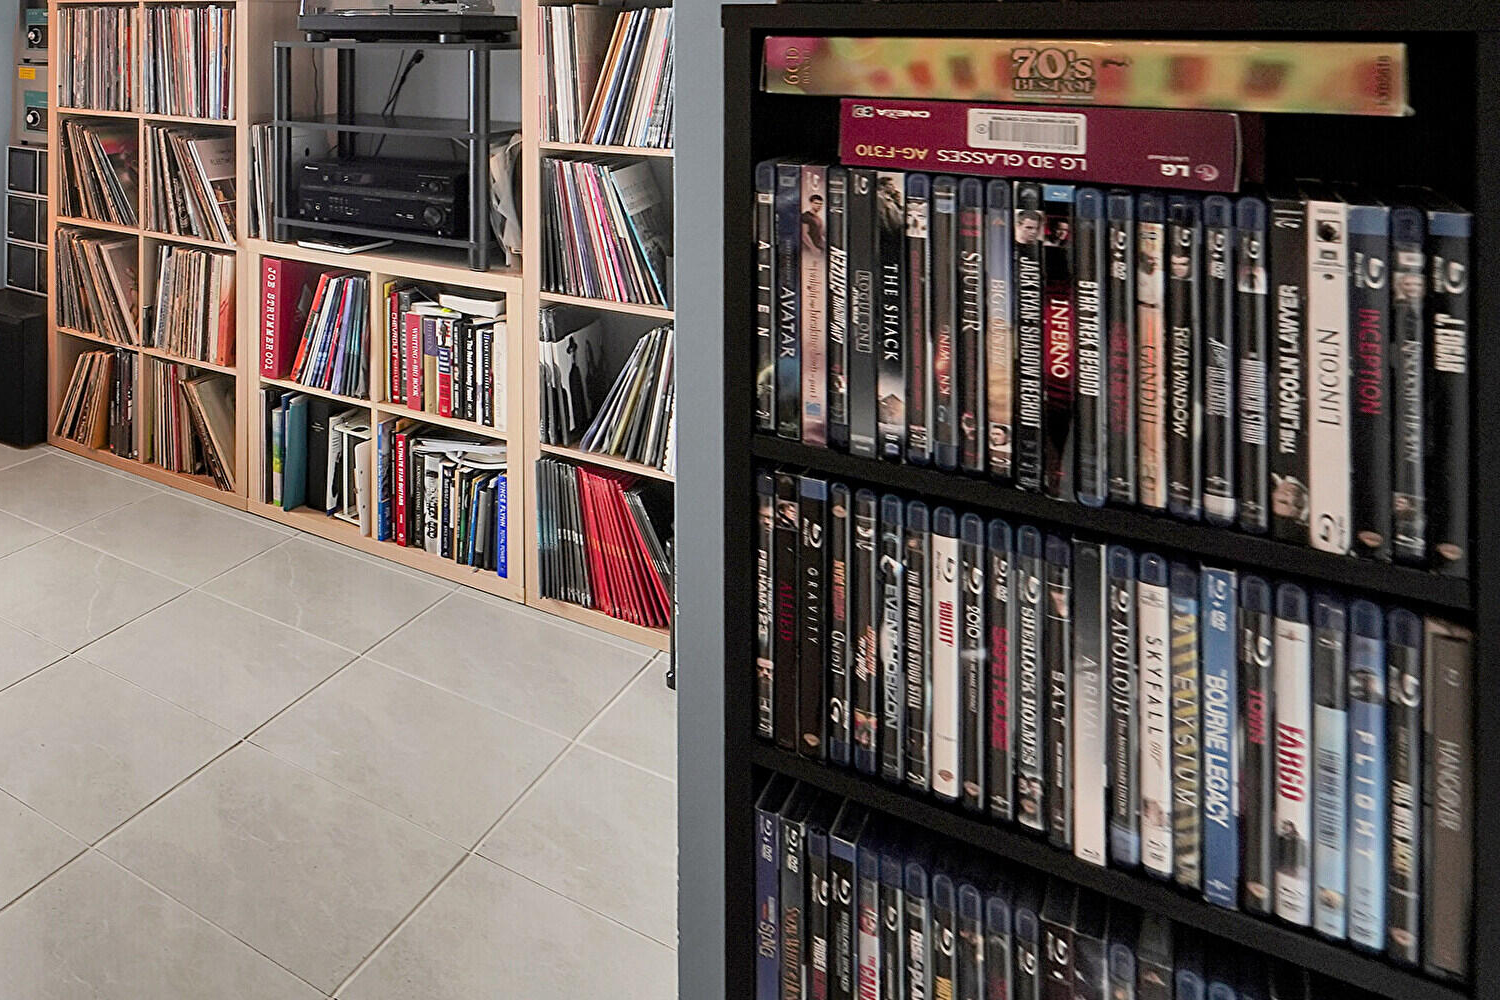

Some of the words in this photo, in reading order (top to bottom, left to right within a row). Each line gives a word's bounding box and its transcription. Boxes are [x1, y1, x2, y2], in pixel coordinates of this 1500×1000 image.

[1011, 47, 1094, 80] 70's
[855, 143, 929, 160] AG-F310
[937, 149, 1025, 166] GLASSES
[1028, 154, 1058, 169] 3D
[1062, 157, 1087, 171] LG
[1160, 164, 1190, 177] LG
[267, 267, 276, 289] JOE
[758, 240, 770, 337] ALIEN
[830, 245, 847, 296] CITIZEN
[884, 263, 899, 296] THE
[961, 250, 982, 331] SHUTTER
[1020, 256, 1039, 289] JACK
[265, 292, 276, 350] STRUMMER
[780, 286, 796, 357] AVATAR
[1078, 280, 1100, 314] STAR
[1278, 284, 1298, 350] LAWYER
[391, 312, 399, 359] CHEVROLET
[466, 340, 474, 350] The
[884, 304, 899, 360] SHACK
[1020, 326, 1040, 377] SHADOW
[1050, 298, 1071, 378] INFERNO
[1079, 314, 1100, 346] TREK
[1171, 326, 1190, 367] REAR
[1433, 327, 1466, 374] EDGAR
[264, 351, 274, 370] 001
[466, 351, 474, 363] Real
[1079, 348, 1100, 396] BEYOND
[1315, 328, 1341, 426] LINCOLN
[1357, 307, 1382, 415] INCEPTION
[1019, 379, 1041, 429] RECRUIT
[1171, 368, 1190, 438] WINDOW
[1278, 355, 1300, 430] LINCOLN
[1279, 430, 1296, 454] THE
[758, 549, 768, 604] PELHAM
[907, 585, 921, 604] DAY
[805, 567, 819, 645] GRAVITY
[965, 604, 981, 638] 2010
[907, 620, 921, 650] EARTH
[1021, 606, 1037, 692] SHERLOCK
[884, 646, 898, 729] HORIZON
[907, 651, 921, 682] STOOD
[1146, 635, 1163, 735] SKYFALL
[907, 683, 921, 709] STILL
[1082, 655, 1097, 739] ARRIVAL
[1205, 674, 1227, 750] BOURNE
[1021, 695, 1037, 765] HOLMES
[1174, 674, 1196, 808] ELYSIUM
[1277, 722, 1306, 803] FARGO
[1437, 739, 1461, 832] HANGOVER
[1206, 751, 1229, 827] LEGACY
[1356, 729, 1377, 859] FLIGHT
[909, 928, 924, 963] RISE
[859, 963, 877, 1000] CAIN
